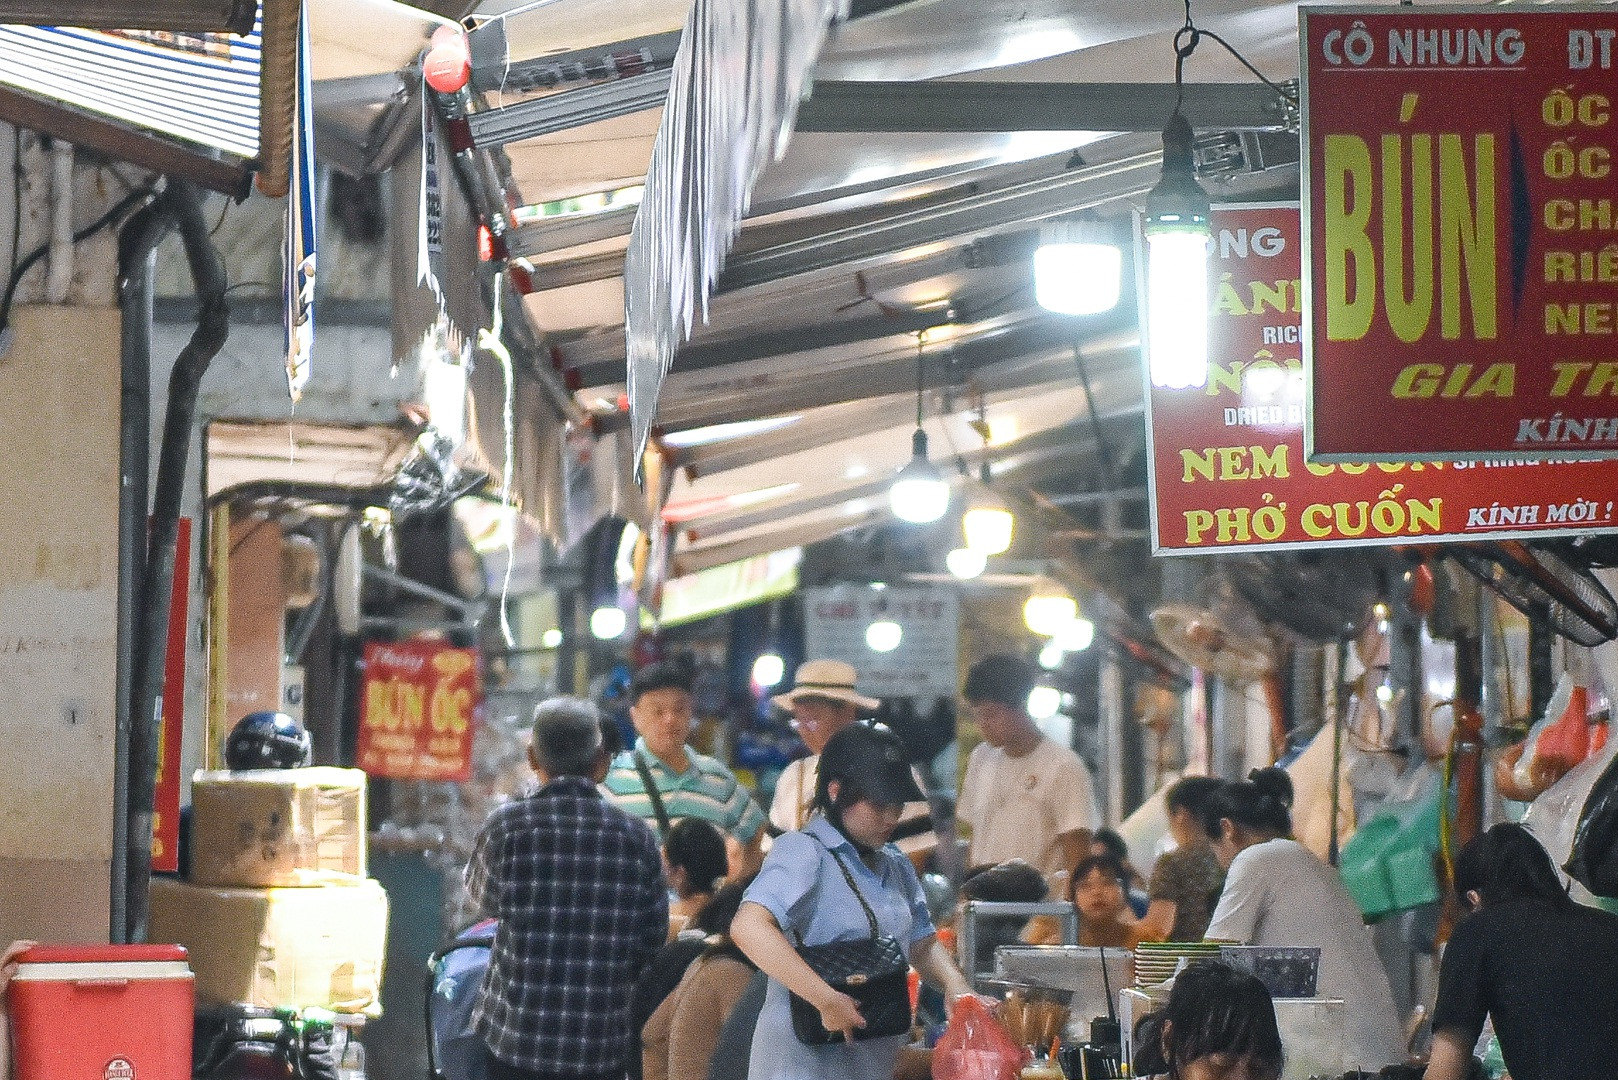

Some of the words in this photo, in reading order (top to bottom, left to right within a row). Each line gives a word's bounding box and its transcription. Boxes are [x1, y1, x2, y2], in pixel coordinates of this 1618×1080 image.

[1322, 20, 1375, 67] CÔ
[1387, 27, 1526, 66] NHUNG
[1542, 82, 1610, 126] ỐC
[1542, 135, 1610, 178] ỐC
[1323, 93, 1497, 343] BÚN
[1391, 361, 1516, 398] GIA
[1224, 406, 1285, 426] DRIED
[1178, 445, 1291, 483] NEM
[1183, 494, 1288, 544] PHỞ
[1301, 484, 1443, 537] CUỐN
[1466, 501, 1540, 527] KÍNH
[1545, 497, 1599, 523] MỜI
